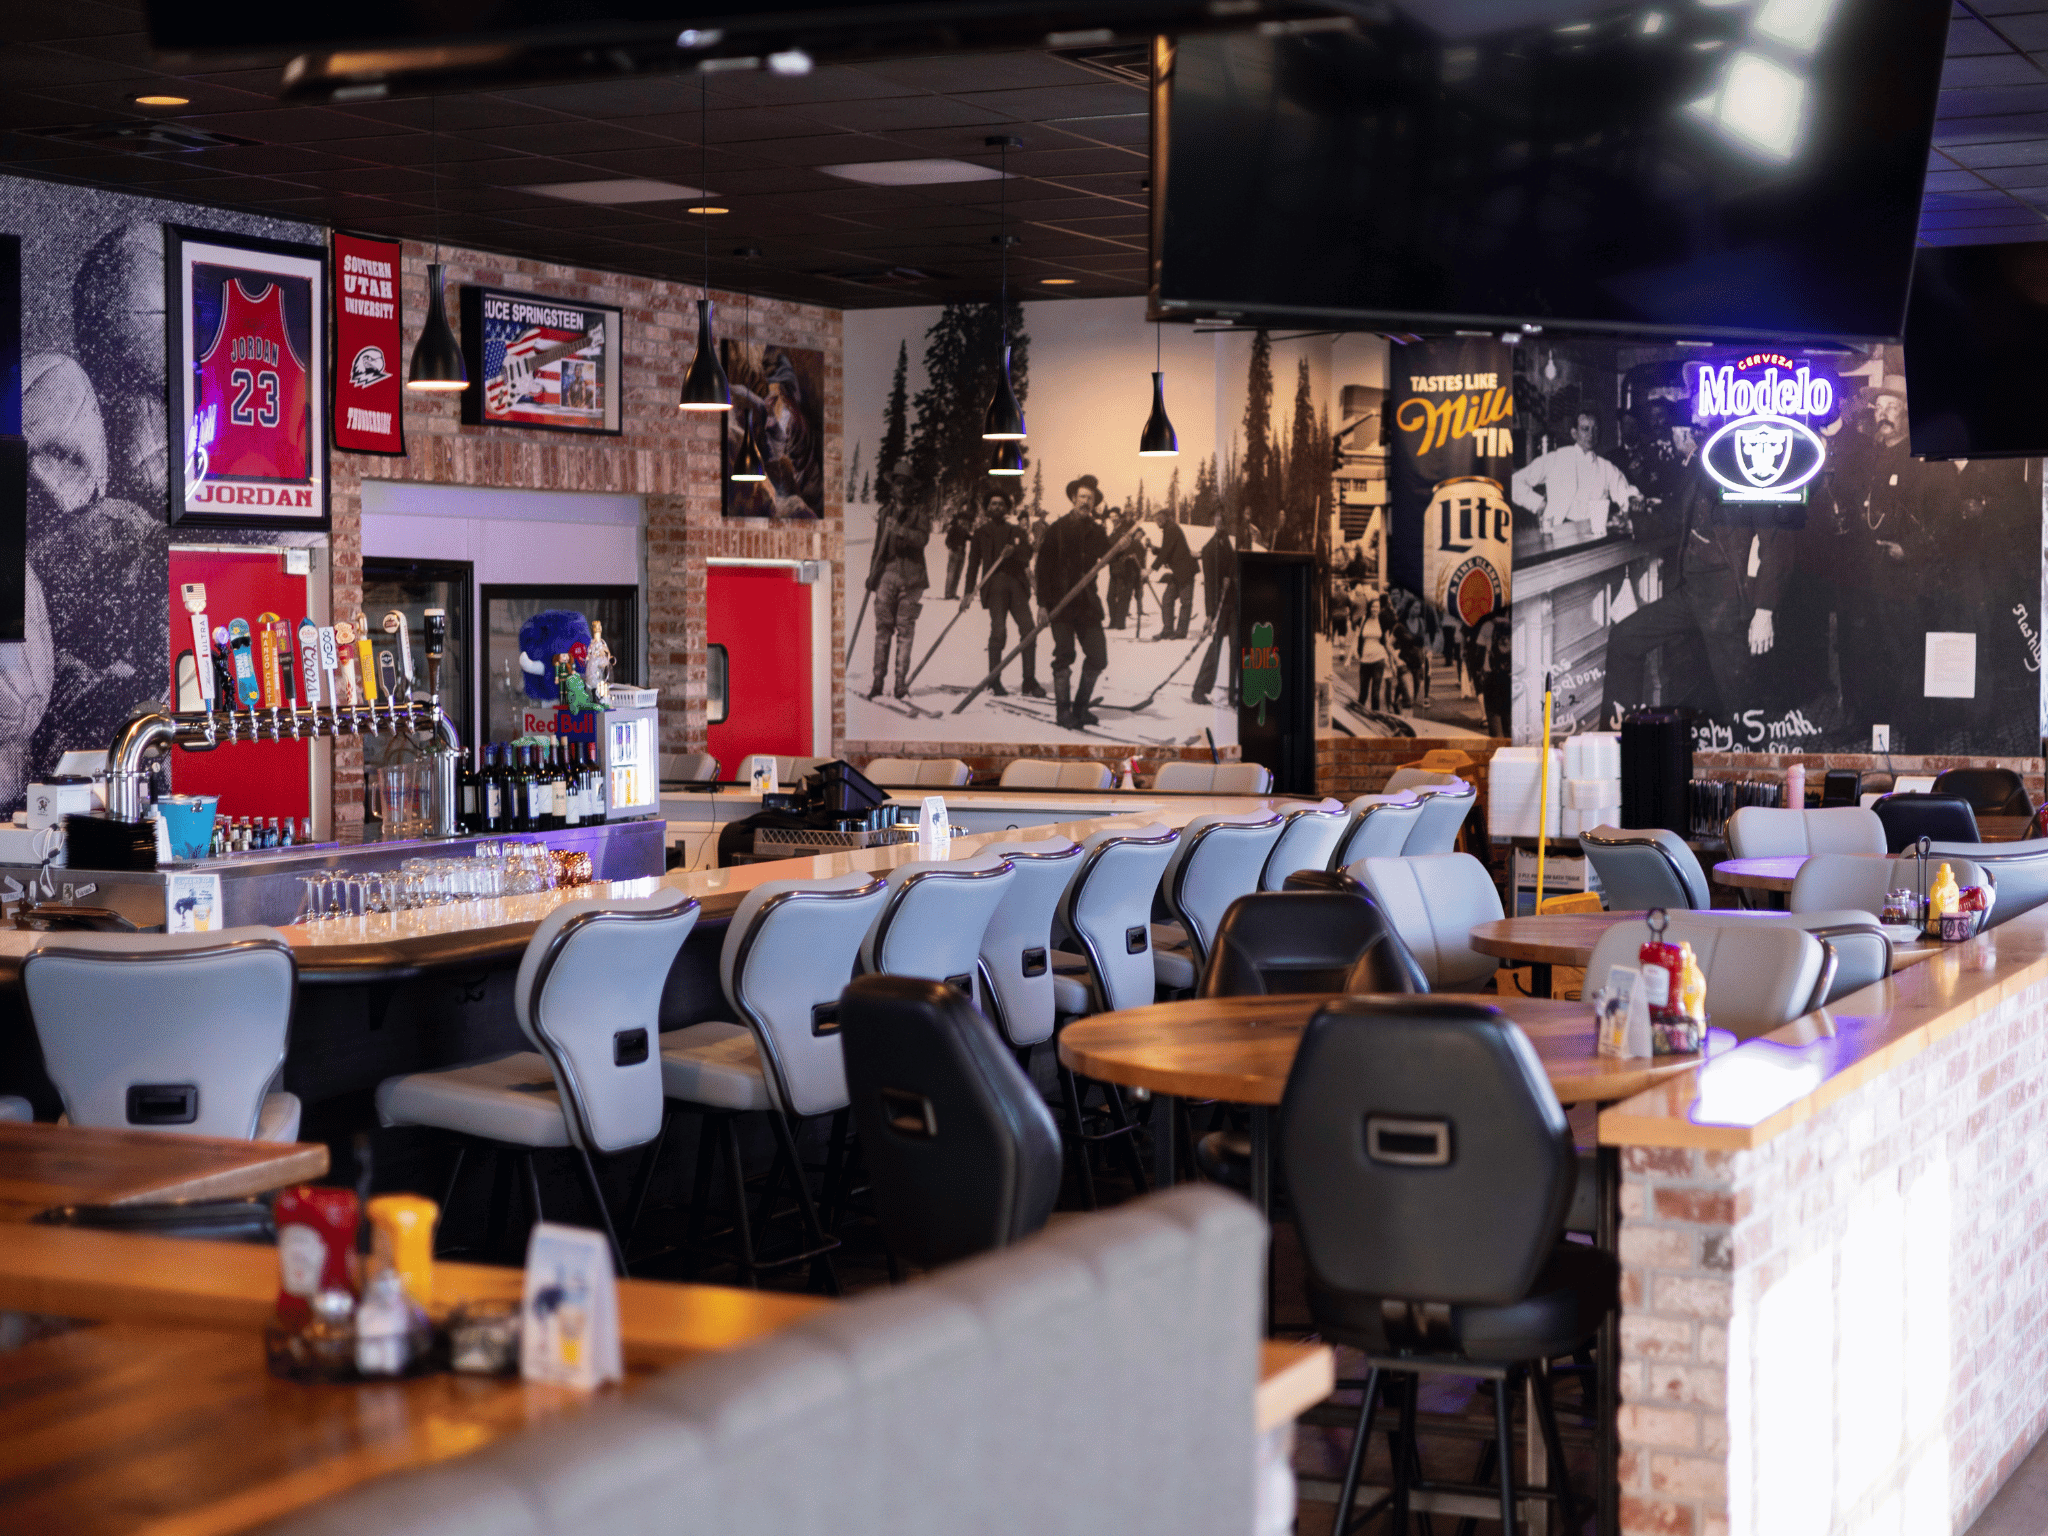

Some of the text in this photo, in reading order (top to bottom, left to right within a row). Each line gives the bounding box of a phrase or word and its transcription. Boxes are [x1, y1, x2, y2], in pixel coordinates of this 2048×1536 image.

[343, 254, 392, 279] SOUTHERN
[343, 274, 393, 299] UTAH
[344, 296, 395, 320] UNIVERSITY
[512, 303, 584, 331] SPRINGSTEEN
[230, 336, 279, 368] JORDAN
[1737, 353, 1794, 371] CERVEZA
[1410, 372, 1498, 393] TASTES LIKE
[1698, 365, 1833, 417] Modelo
[230, 368, 280, 428] 23
[194, 485, 313, 508] JORDAN
[1438, 497, 1510, 554] Lite
[1453, 558, 1475, 583] FINE
[1475, 556, 1500, 595] PILSNER
[199, 619, 209, 653] ULTRA
[275, 628, 287, 638] IPA
[322, 630, 335, 666] 805
[1241, 646, 1280, 670] LADIES
[234, 653, 245, 679] KONA
[261, 632, 272, 702] MANGO CART
[302, 645, 318, 693] Coors
[524, 713, 594, 734] Red Bull
